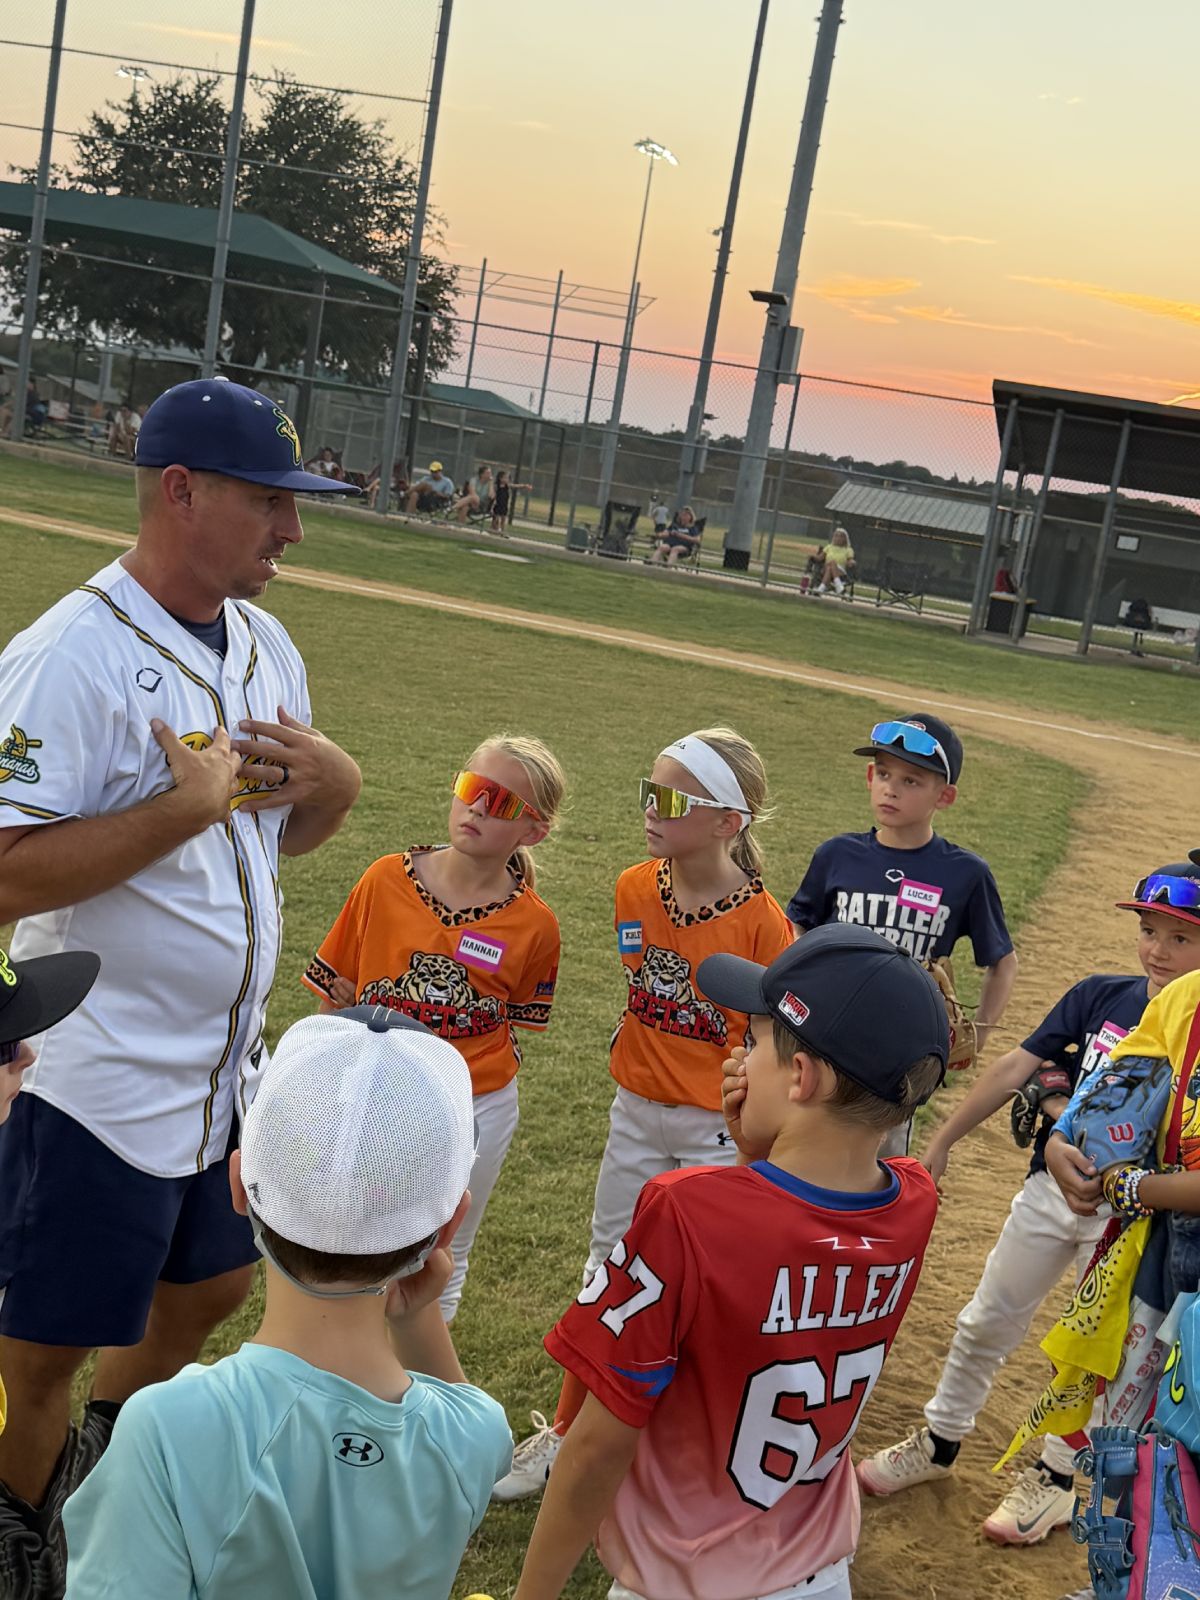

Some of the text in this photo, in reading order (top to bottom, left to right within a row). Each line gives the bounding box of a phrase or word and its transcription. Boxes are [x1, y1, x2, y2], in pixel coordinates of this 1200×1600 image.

[836, 891, 951, 937] BATTLER
[907, 889, 934, 902] LUCAS
[461, 939, 499, 959] HANNAH
[576, 1239, 666, 1338] 67
[760, 1256, 916, 1335] ALLEN
[726, 1339, 888, 1511] 67
